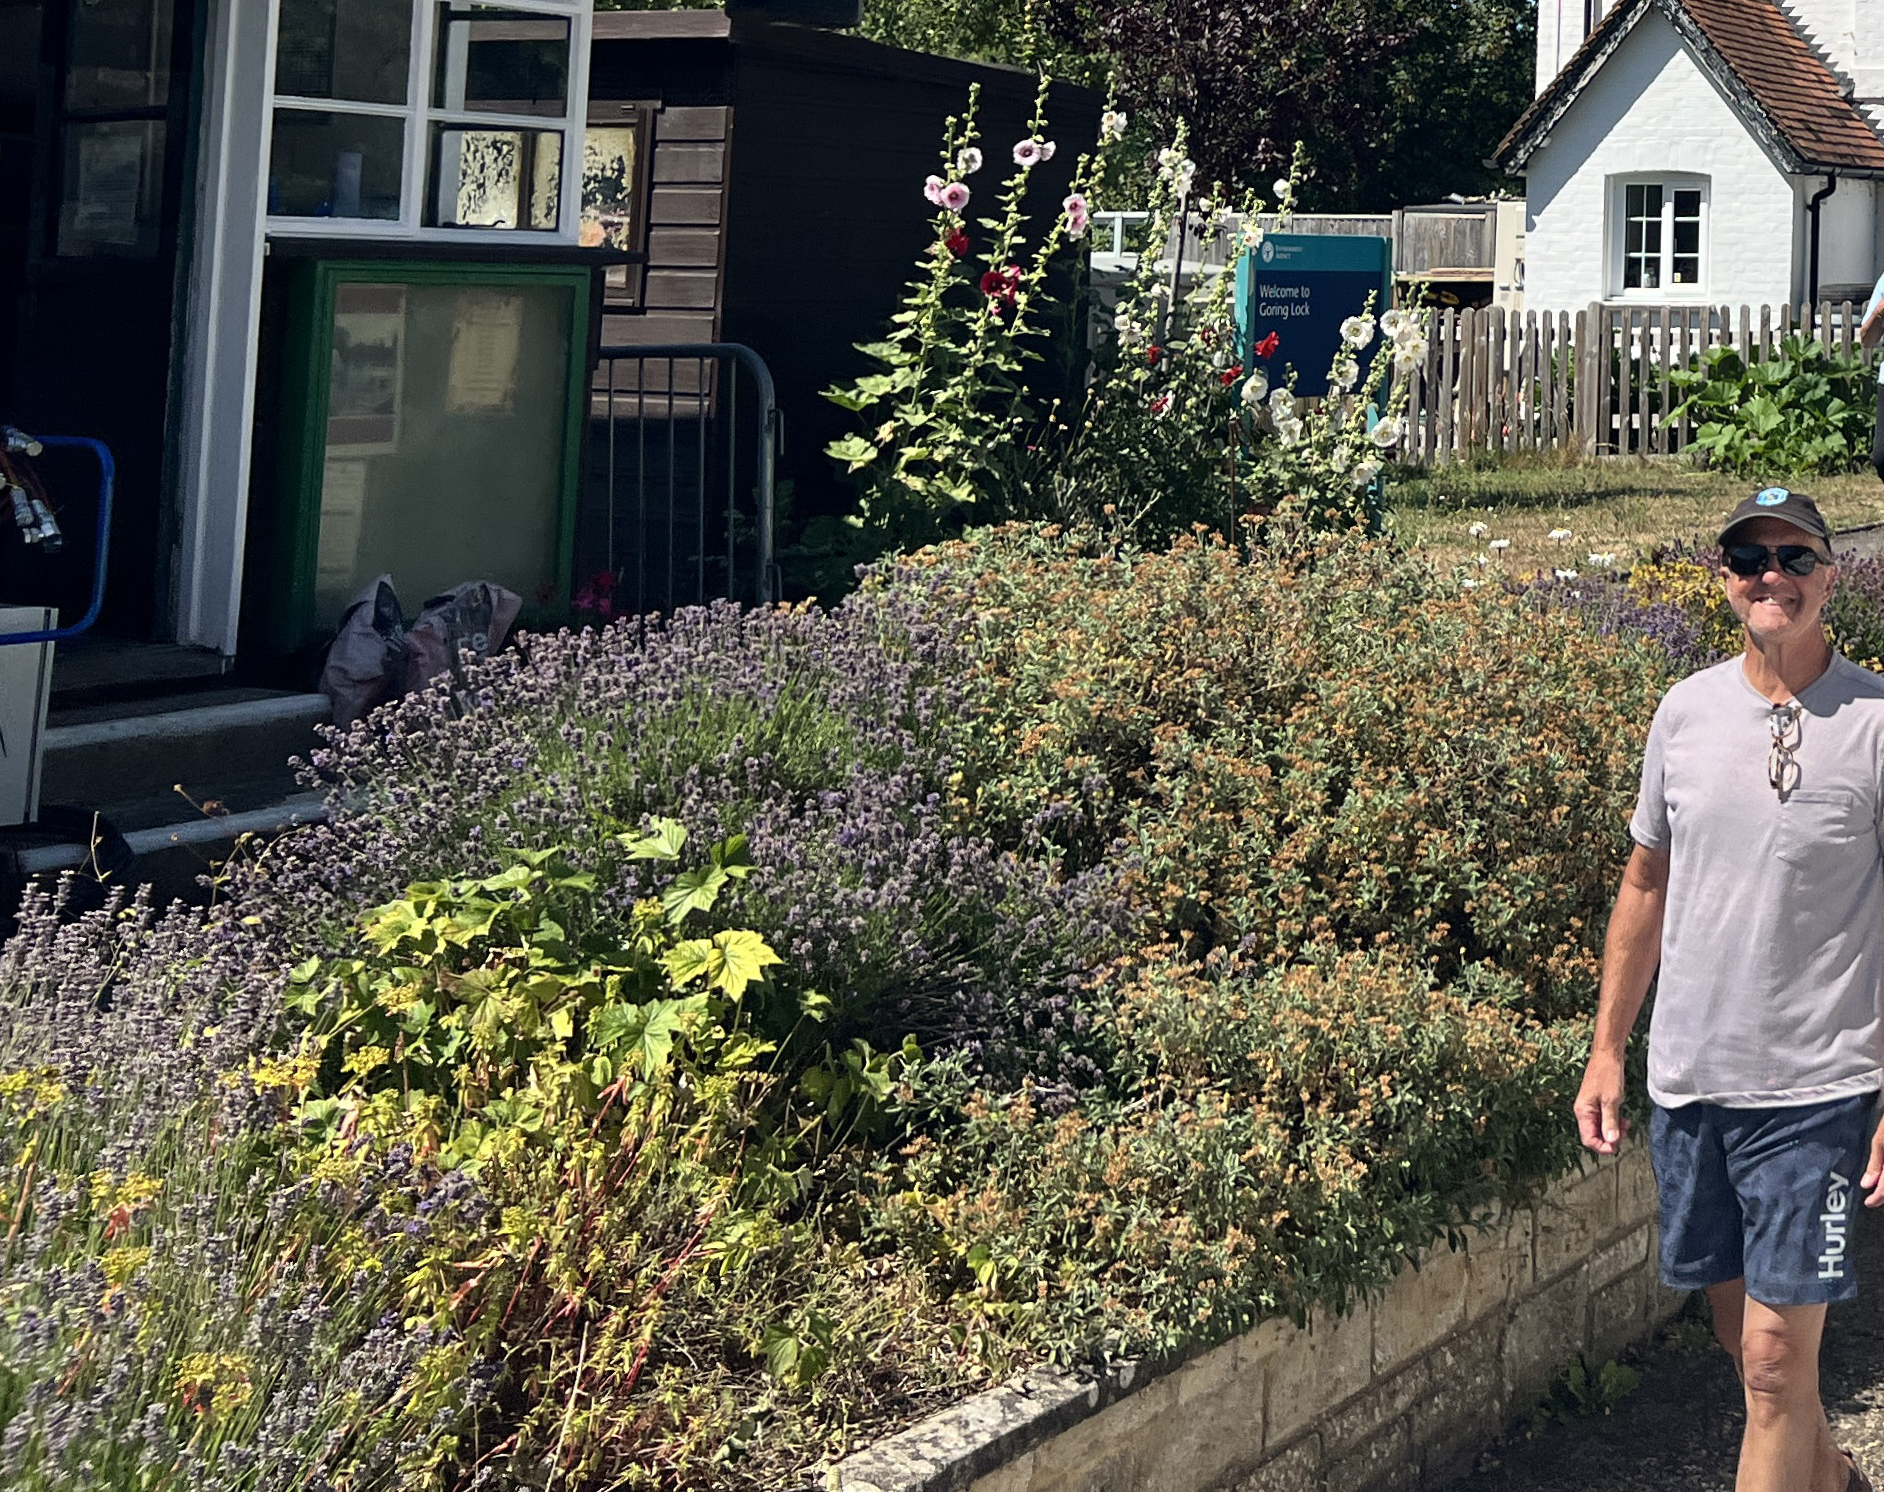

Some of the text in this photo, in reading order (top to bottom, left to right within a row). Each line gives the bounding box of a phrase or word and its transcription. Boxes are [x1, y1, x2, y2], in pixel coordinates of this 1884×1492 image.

[1259, 283, 1310, 299] Welcome to
[1259, 301, 1310, 320] Goring Lock
[1818, 1171, 1849, 1280] Hurley
